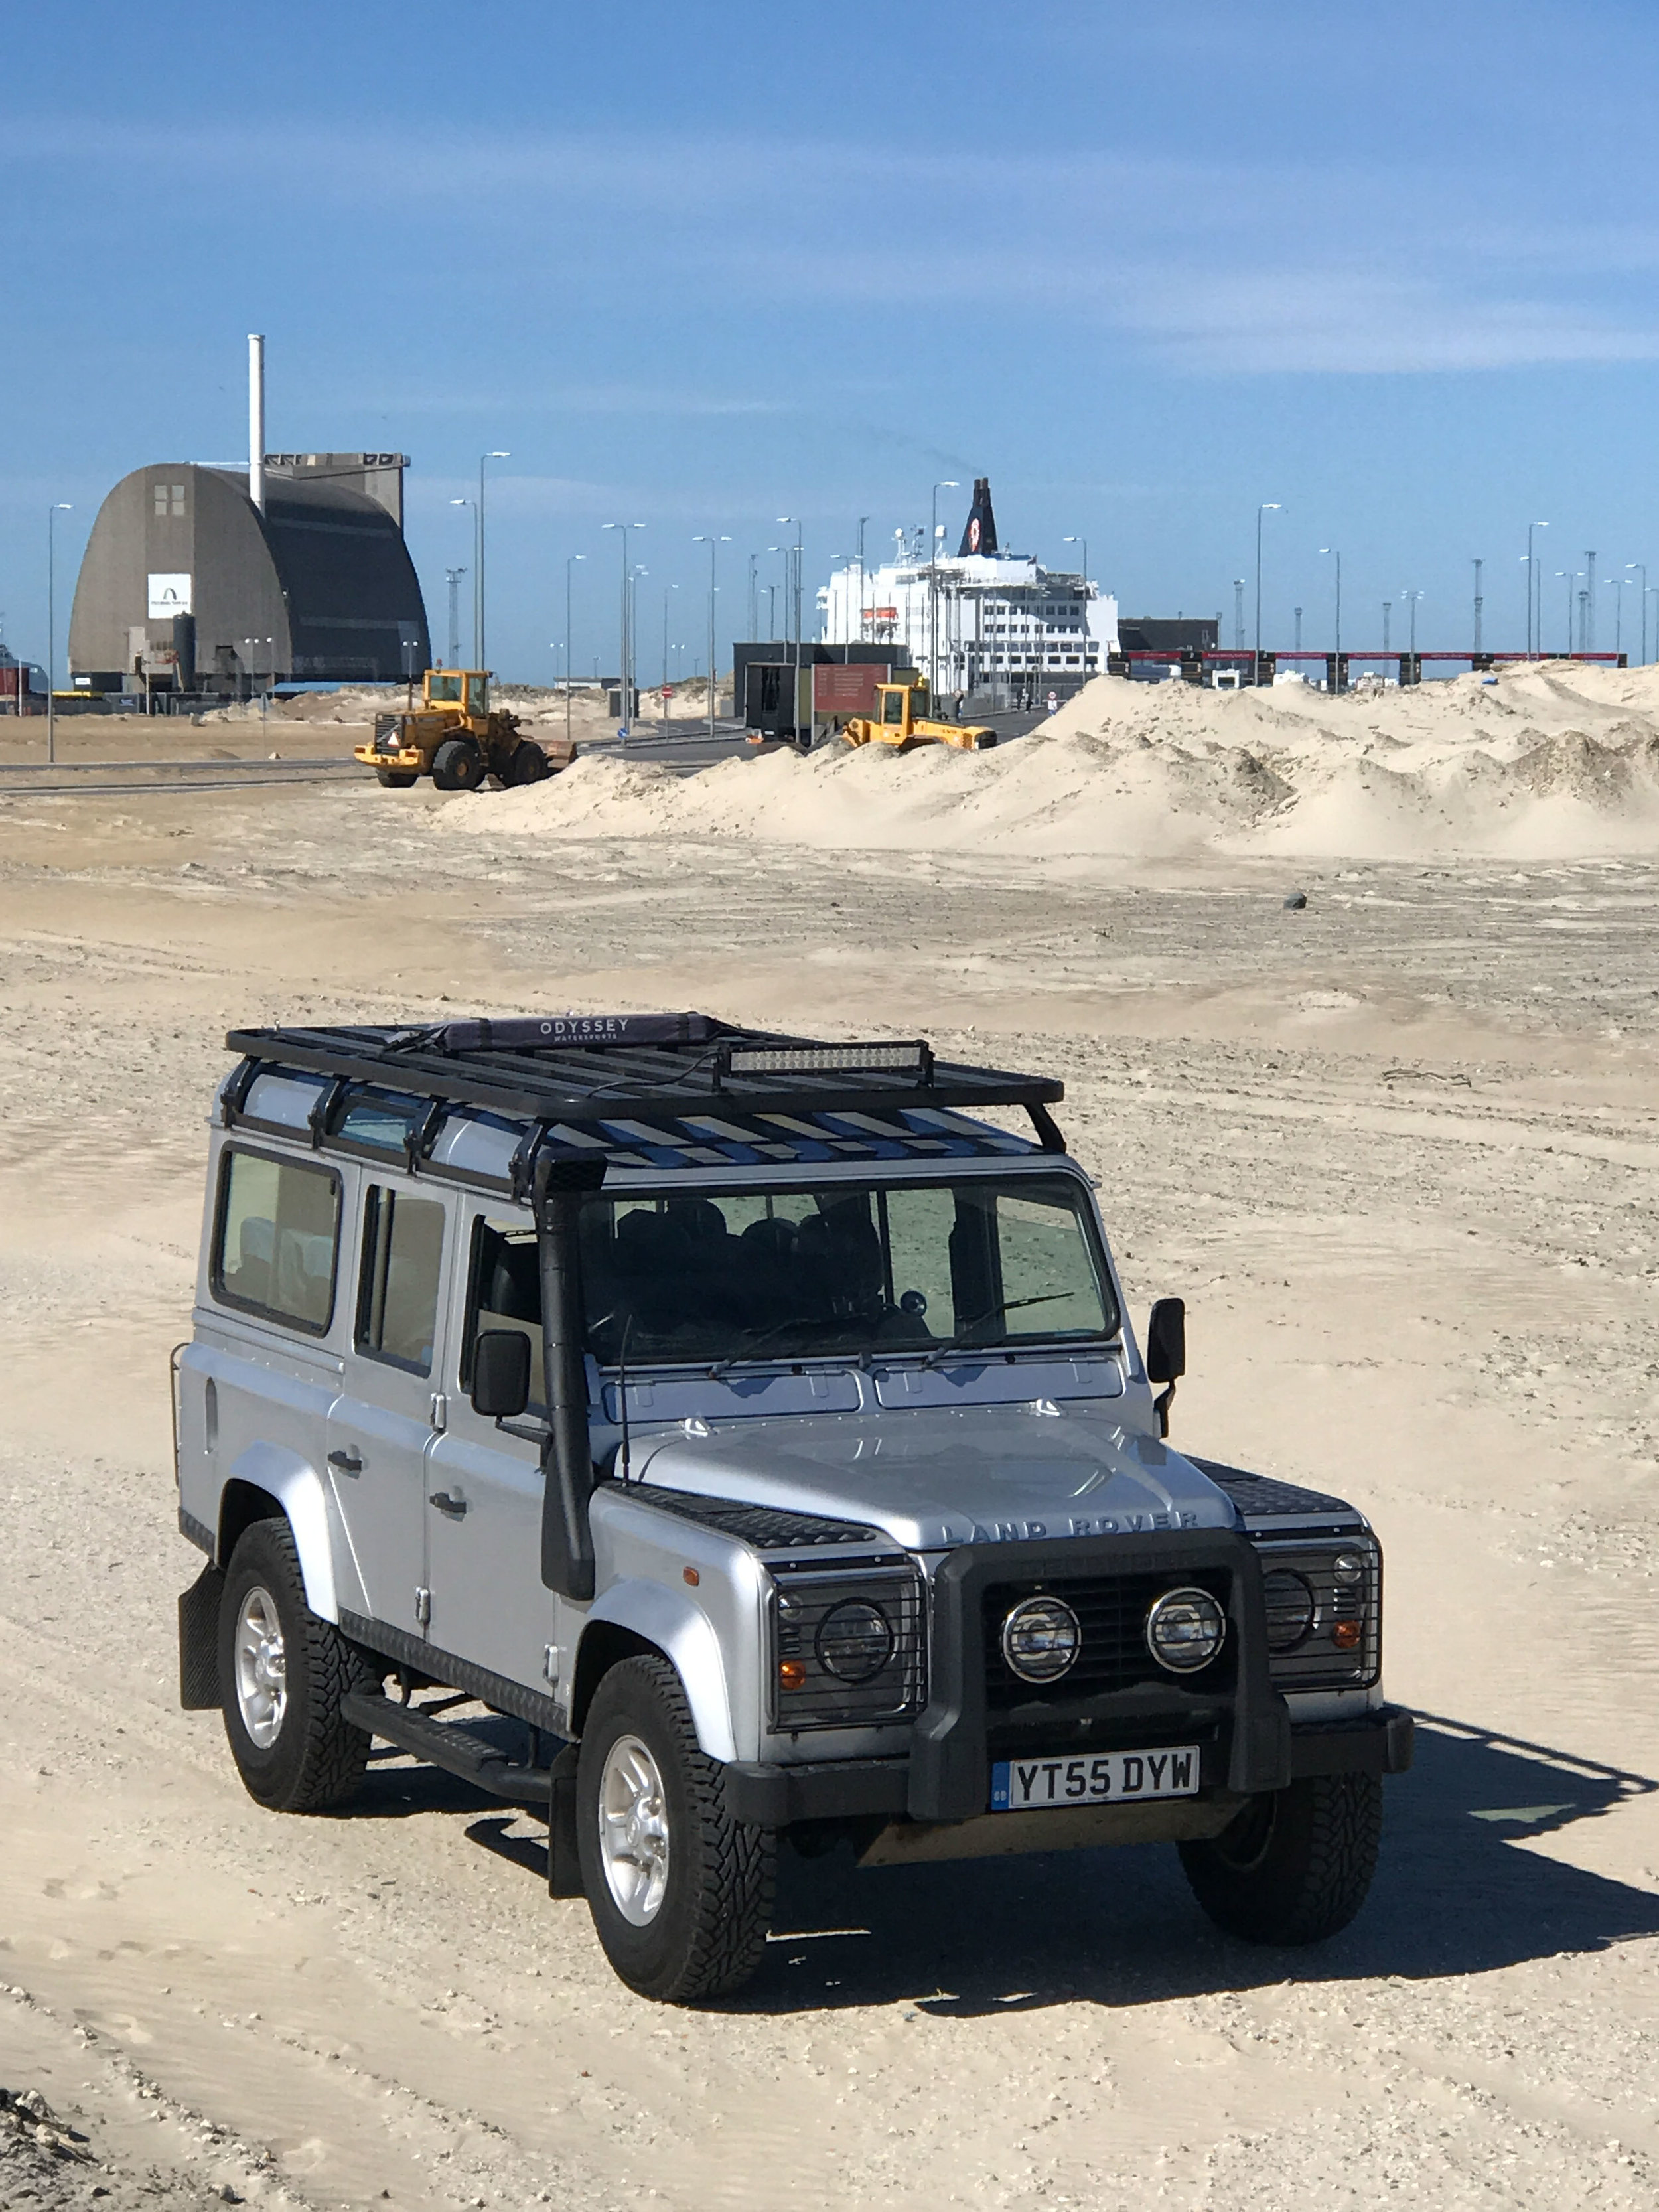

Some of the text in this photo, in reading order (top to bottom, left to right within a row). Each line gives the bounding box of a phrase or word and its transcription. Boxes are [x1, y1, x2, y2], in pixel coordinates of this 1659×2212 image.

[540, 1019, 628, 1035] ODYSSEY
[942, 1511, 1198, 1543] LAND ROVER
[1017, 1753, 1192, 1801] YT55 DYW
[993, 1790, 1007, 1801] GB
